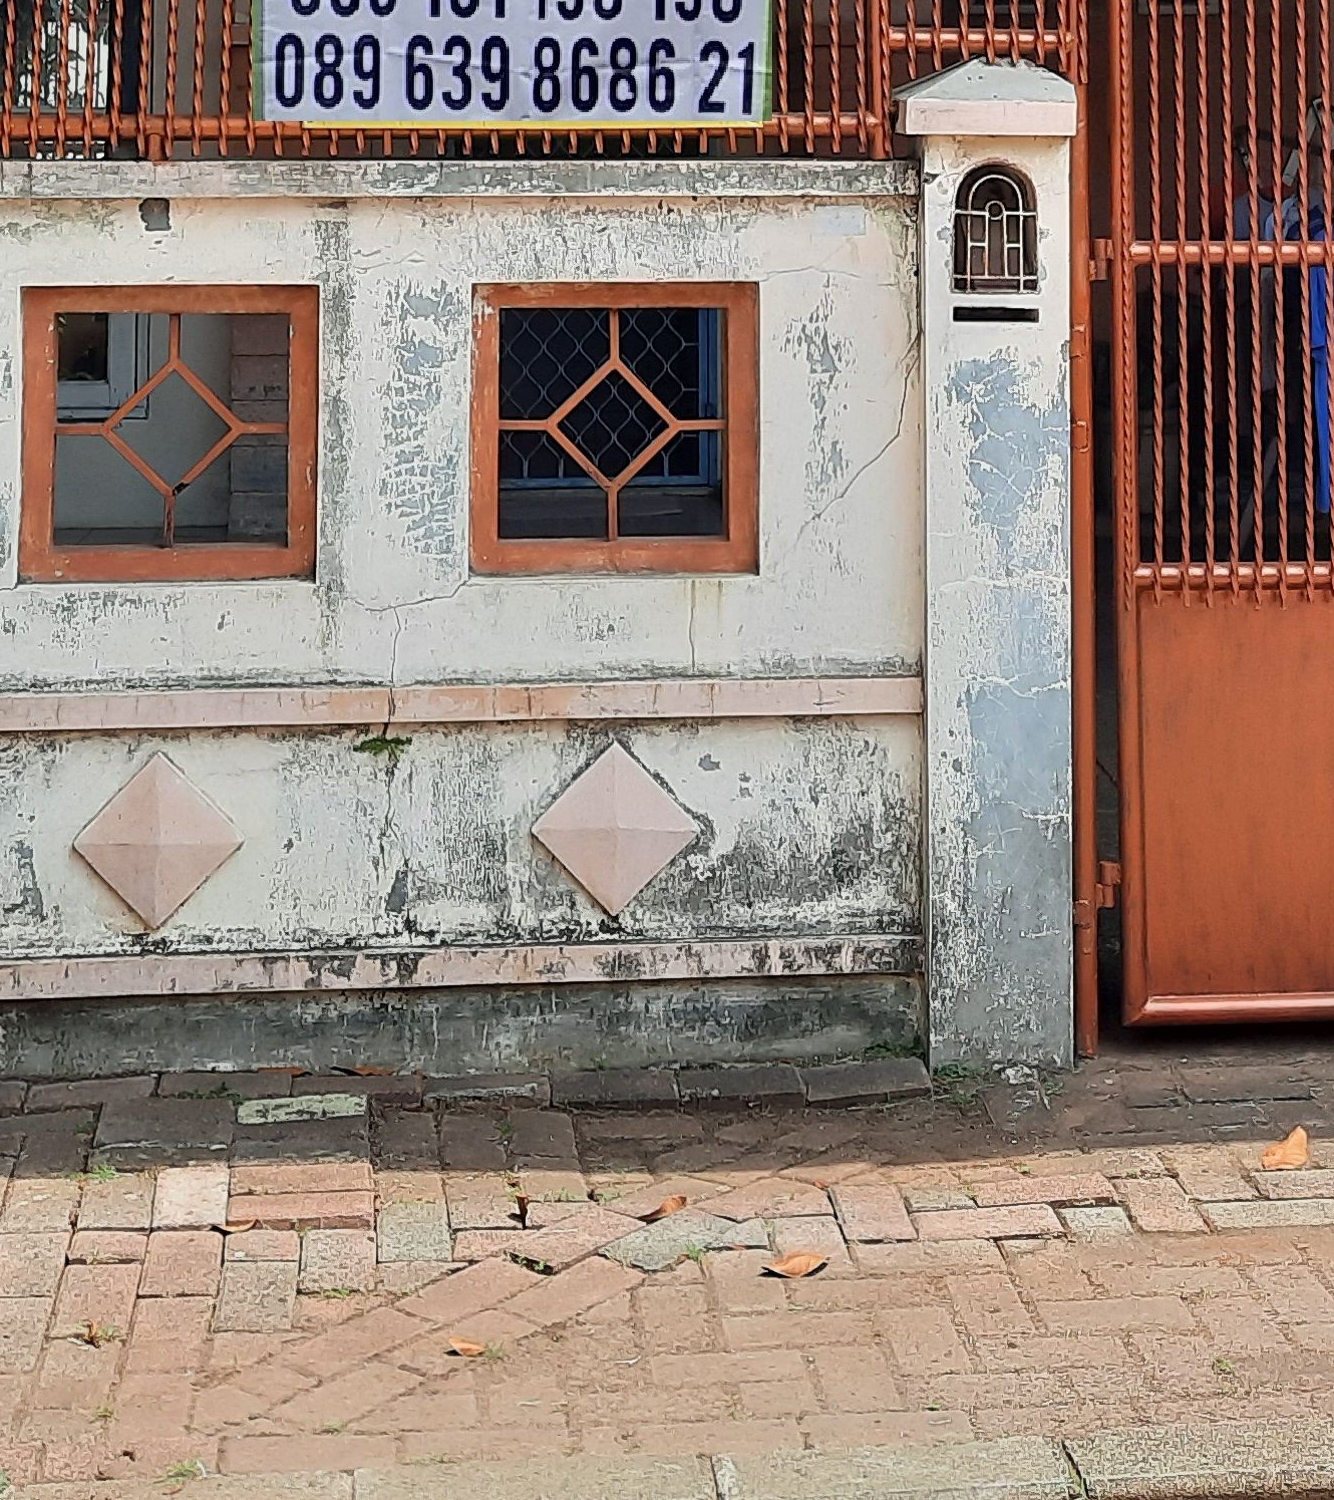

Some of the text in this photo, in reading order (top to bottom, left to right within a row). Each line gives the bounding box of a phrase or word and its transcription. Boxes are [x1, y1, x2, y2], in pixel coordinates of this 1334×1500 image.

[274, 32, 755, 116] 089 639 8686 21
